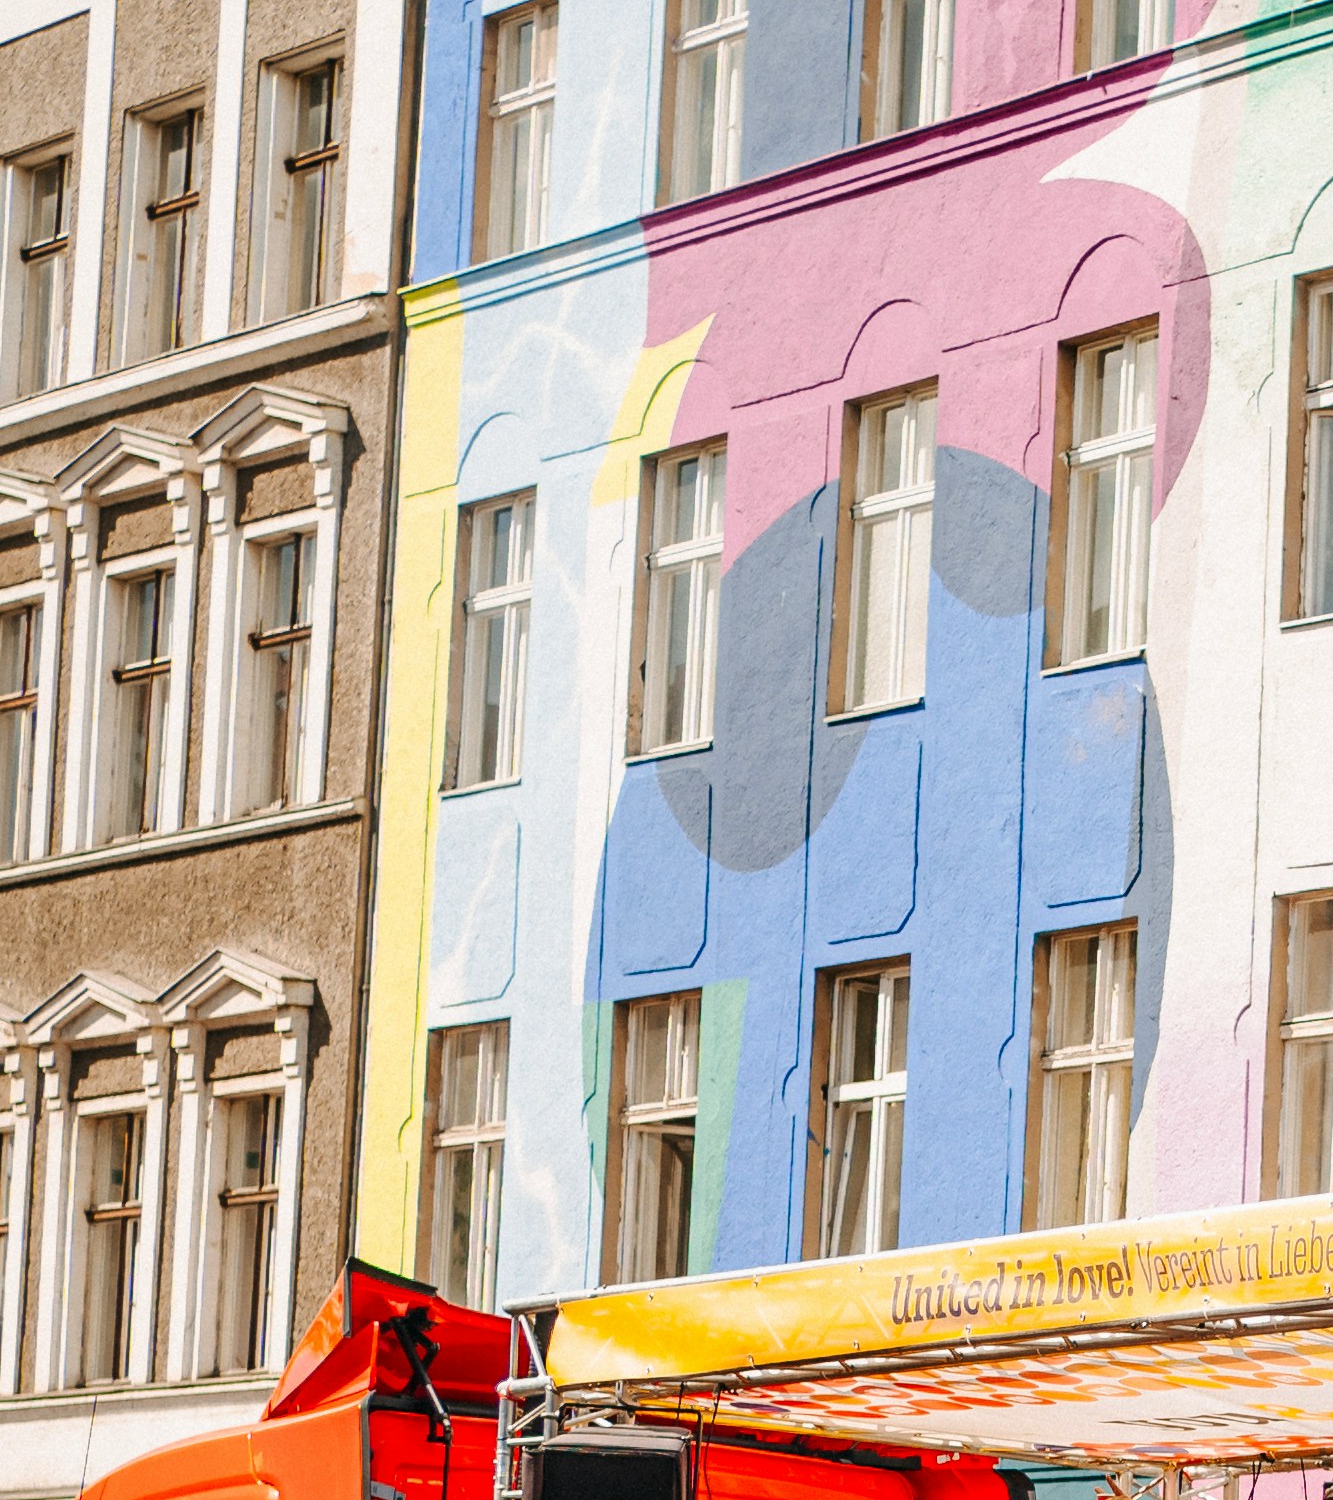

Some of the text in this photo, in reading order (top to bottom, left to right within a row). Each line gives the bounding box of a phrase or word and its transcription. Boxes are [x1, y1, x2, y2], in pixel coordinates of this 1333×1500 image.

[891, 1262, 1004, 1325] United
[1010, 1259, 1047, 1311] in
[1053, 1244, 1133, 1305] love!
[1136, 1237, 1234, 1293] Vereint
[1238, 1232, 1262, 1281] in
